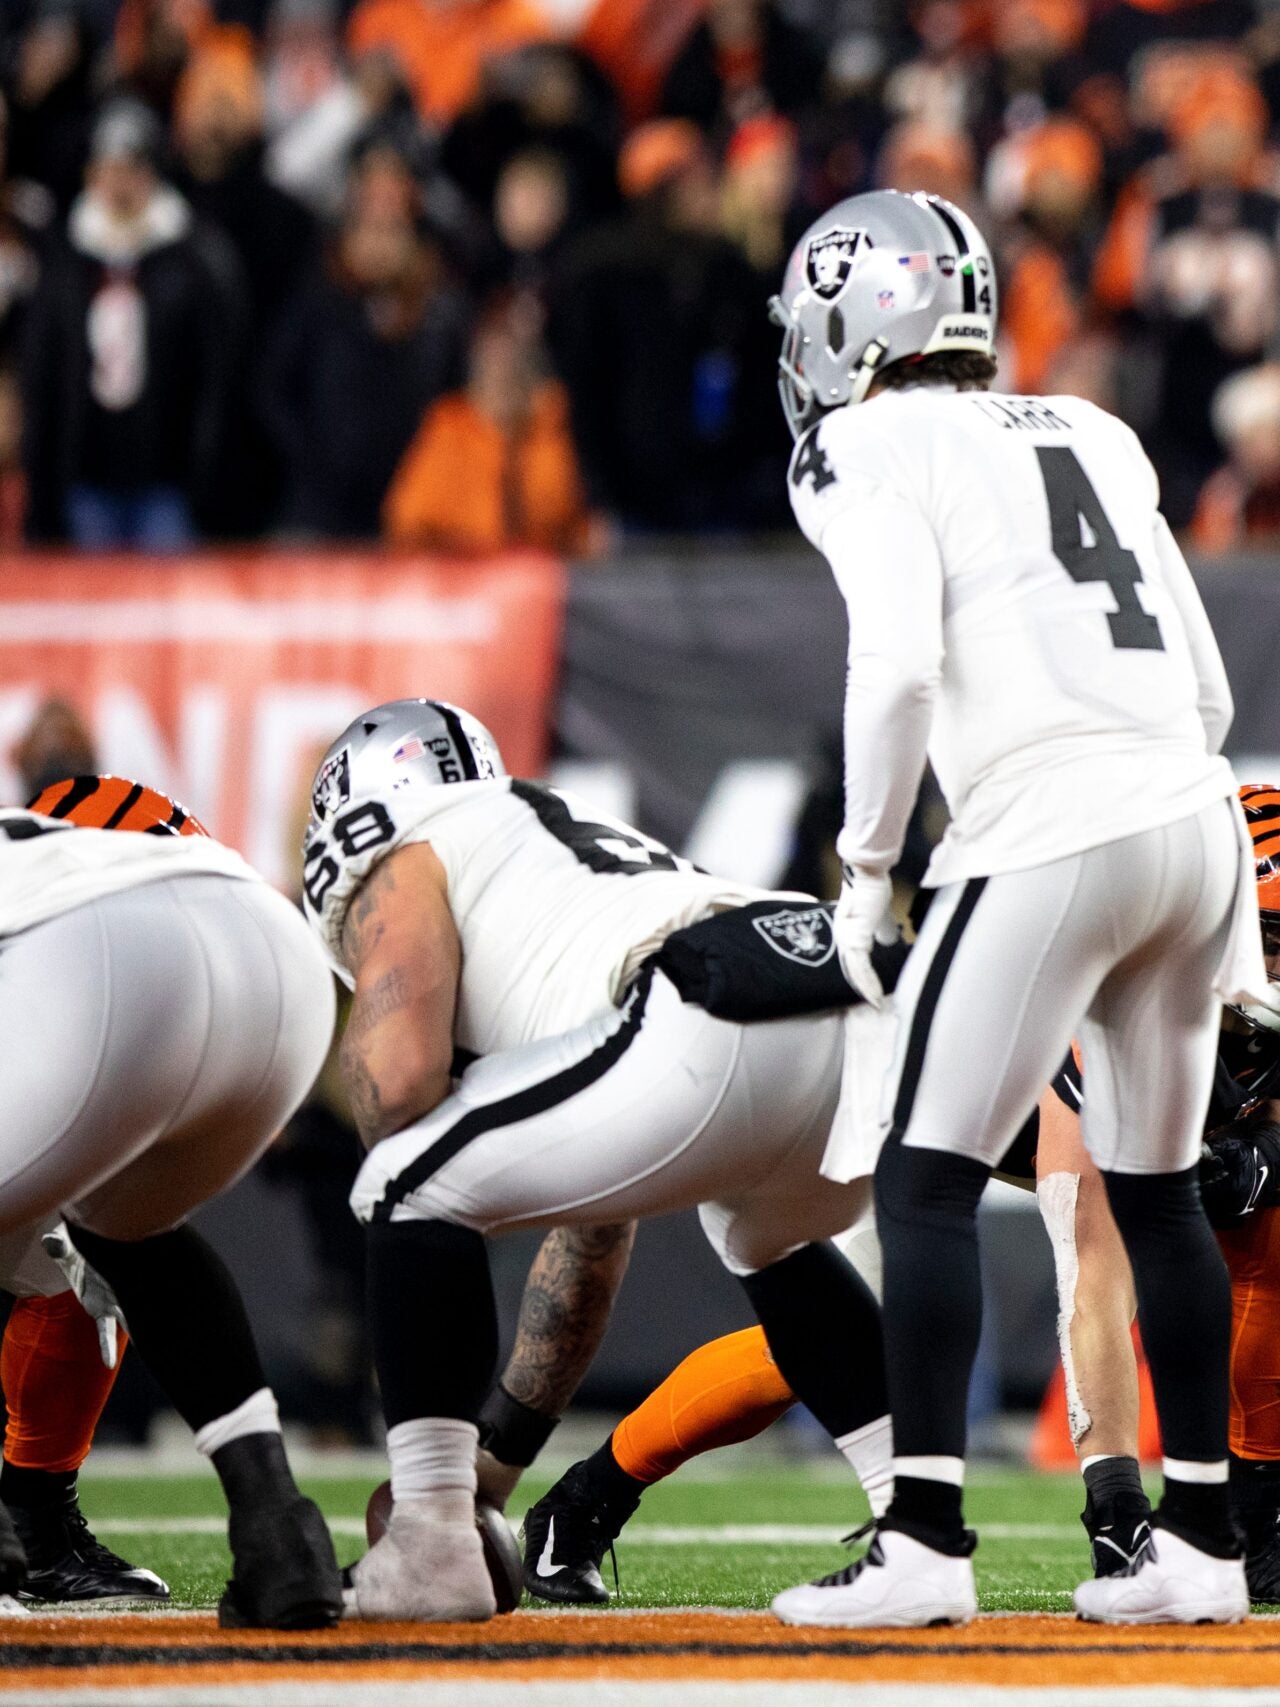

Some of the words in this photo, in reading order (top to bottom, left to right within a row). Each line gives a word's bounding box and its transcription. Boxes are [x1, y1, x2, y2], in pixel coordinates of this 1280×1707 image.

[971, 399, 1072, 431] CARR
[792, 423, 838, 496] 4
[1033, 445, 1167, 652] 4
